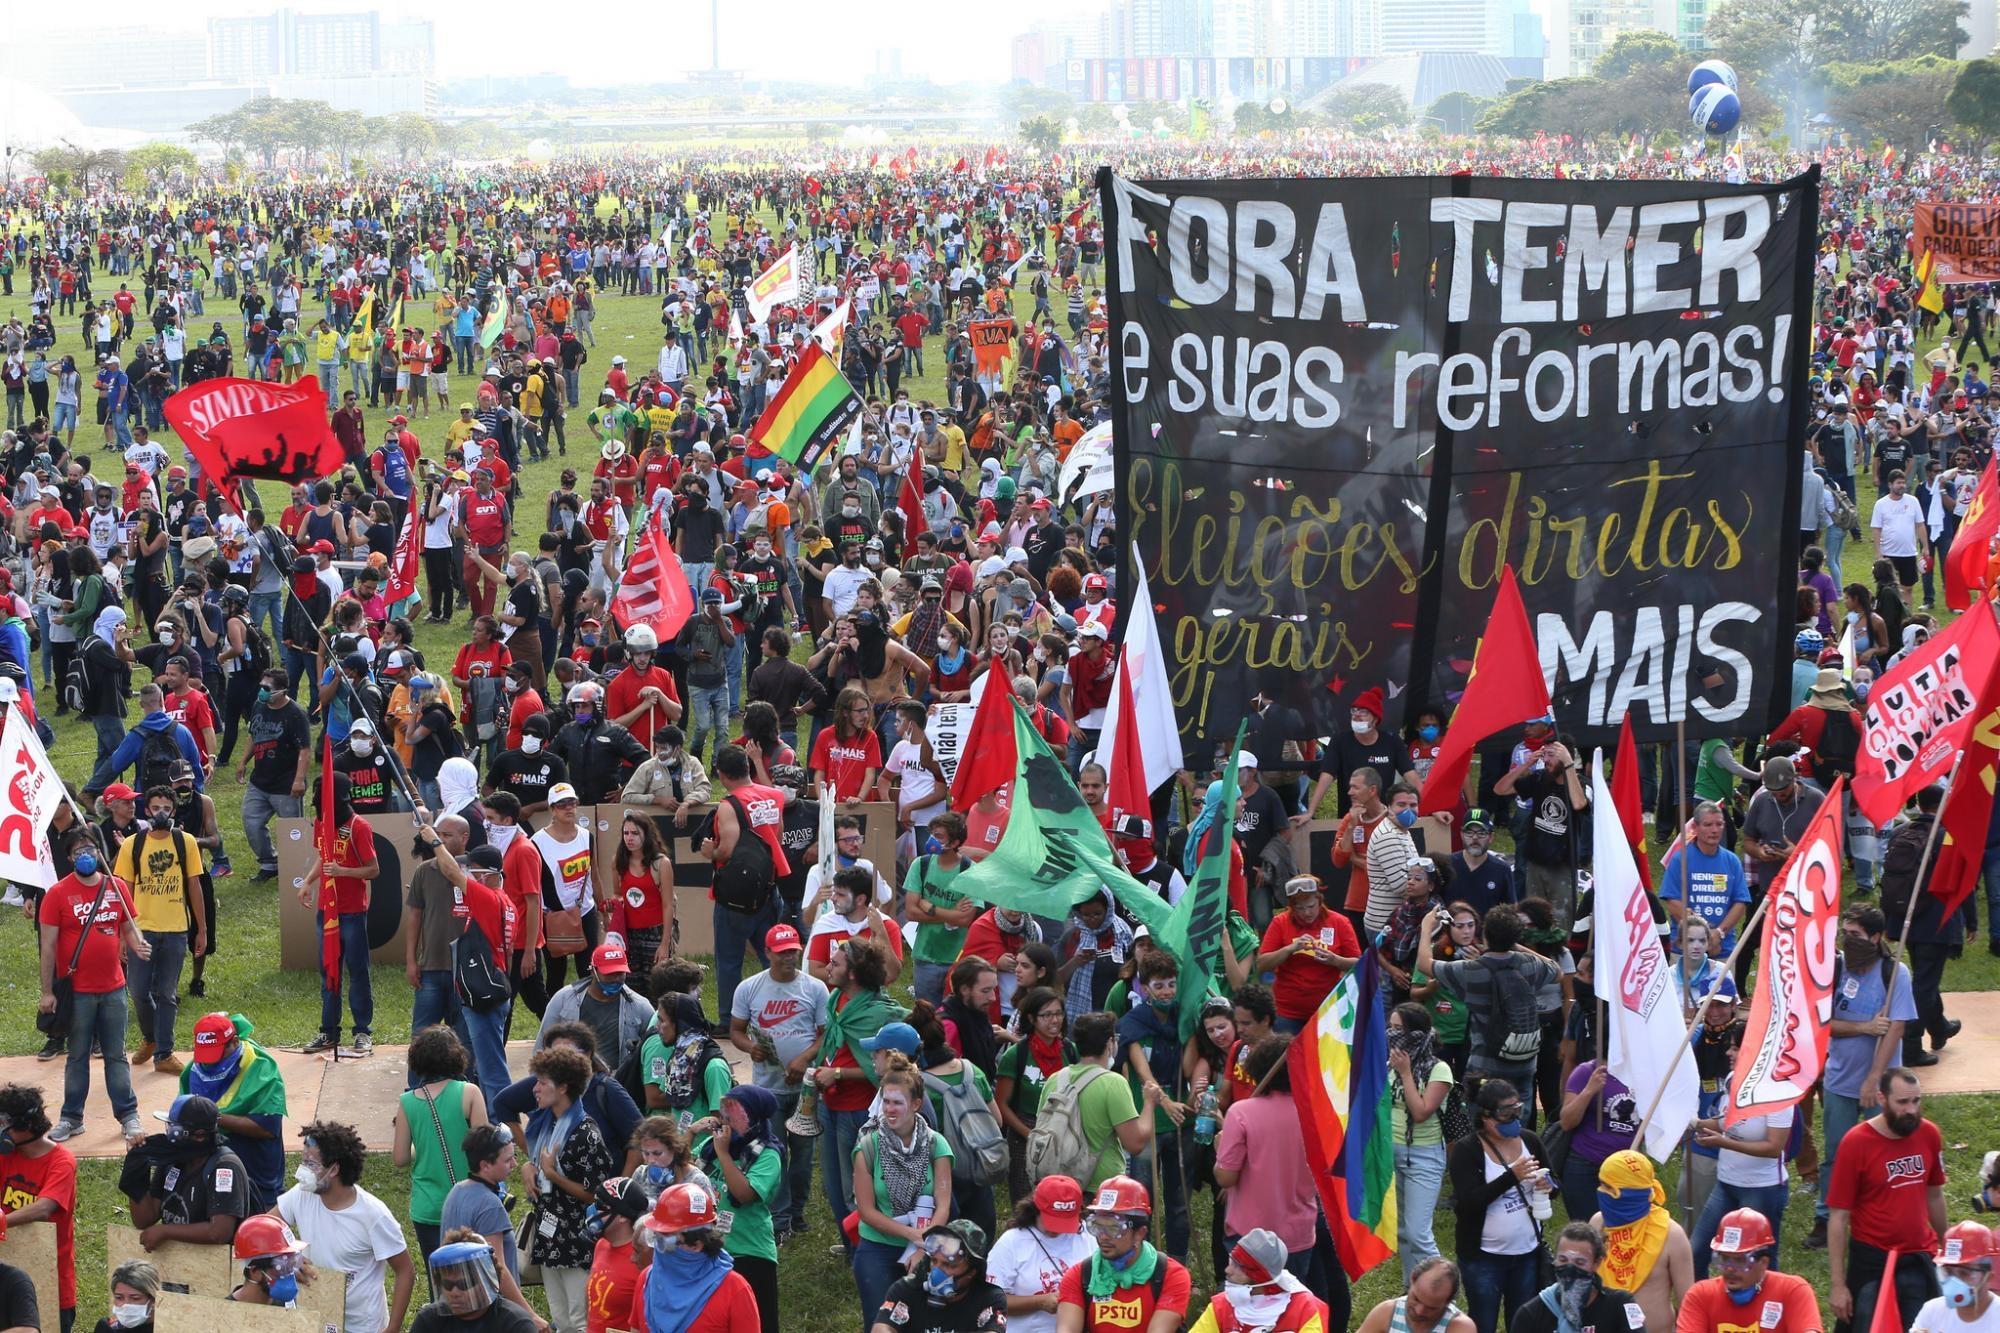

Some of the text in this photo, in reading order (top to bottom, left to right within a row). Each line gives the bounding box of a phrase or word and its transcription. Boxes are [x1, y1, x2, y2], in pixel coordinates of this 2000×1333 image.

[1932, 207, 2000, 237] GREV
[1112, 173, 1770, 323] FORA TEMER
[1967, 240, 2000, 258] DER
[976, 327, 1009, 347] RUA
[1121, 313, 1793, 431] e suas reformas!
[1128, 458, 1752, 616] Eleições diretas
[1169, 602, 1373, 708] gerais
[1536, 601, 1763, 726] MAIS
[1866, 653, 1958, 730] LUTA
[165, 709, 186, 722] UT
[937, 704, 958, 728] tem
[933, 732, 957, 756] não
[349, 767, 380, 785] FORA
[746, 798, 776, 811] CSP
[1691, 872, 1728, 882] NENH
[1691, 884, 1727, 893] DIRE
[73, 900, 111, 916] FOA
[1696, 895, 1729, 904] MENOS!
[78, 911, 118, 925] TMER!
[763, 1000, 800, 1015] NIKE
[1738, 1050, 1770, 1102] POPULAR
[1887, 1155, 1924, 1176] PSTU
[1053, 1201, 1076, 1211] CUT
[1100, 1305, 1138, 1320] PSTU
